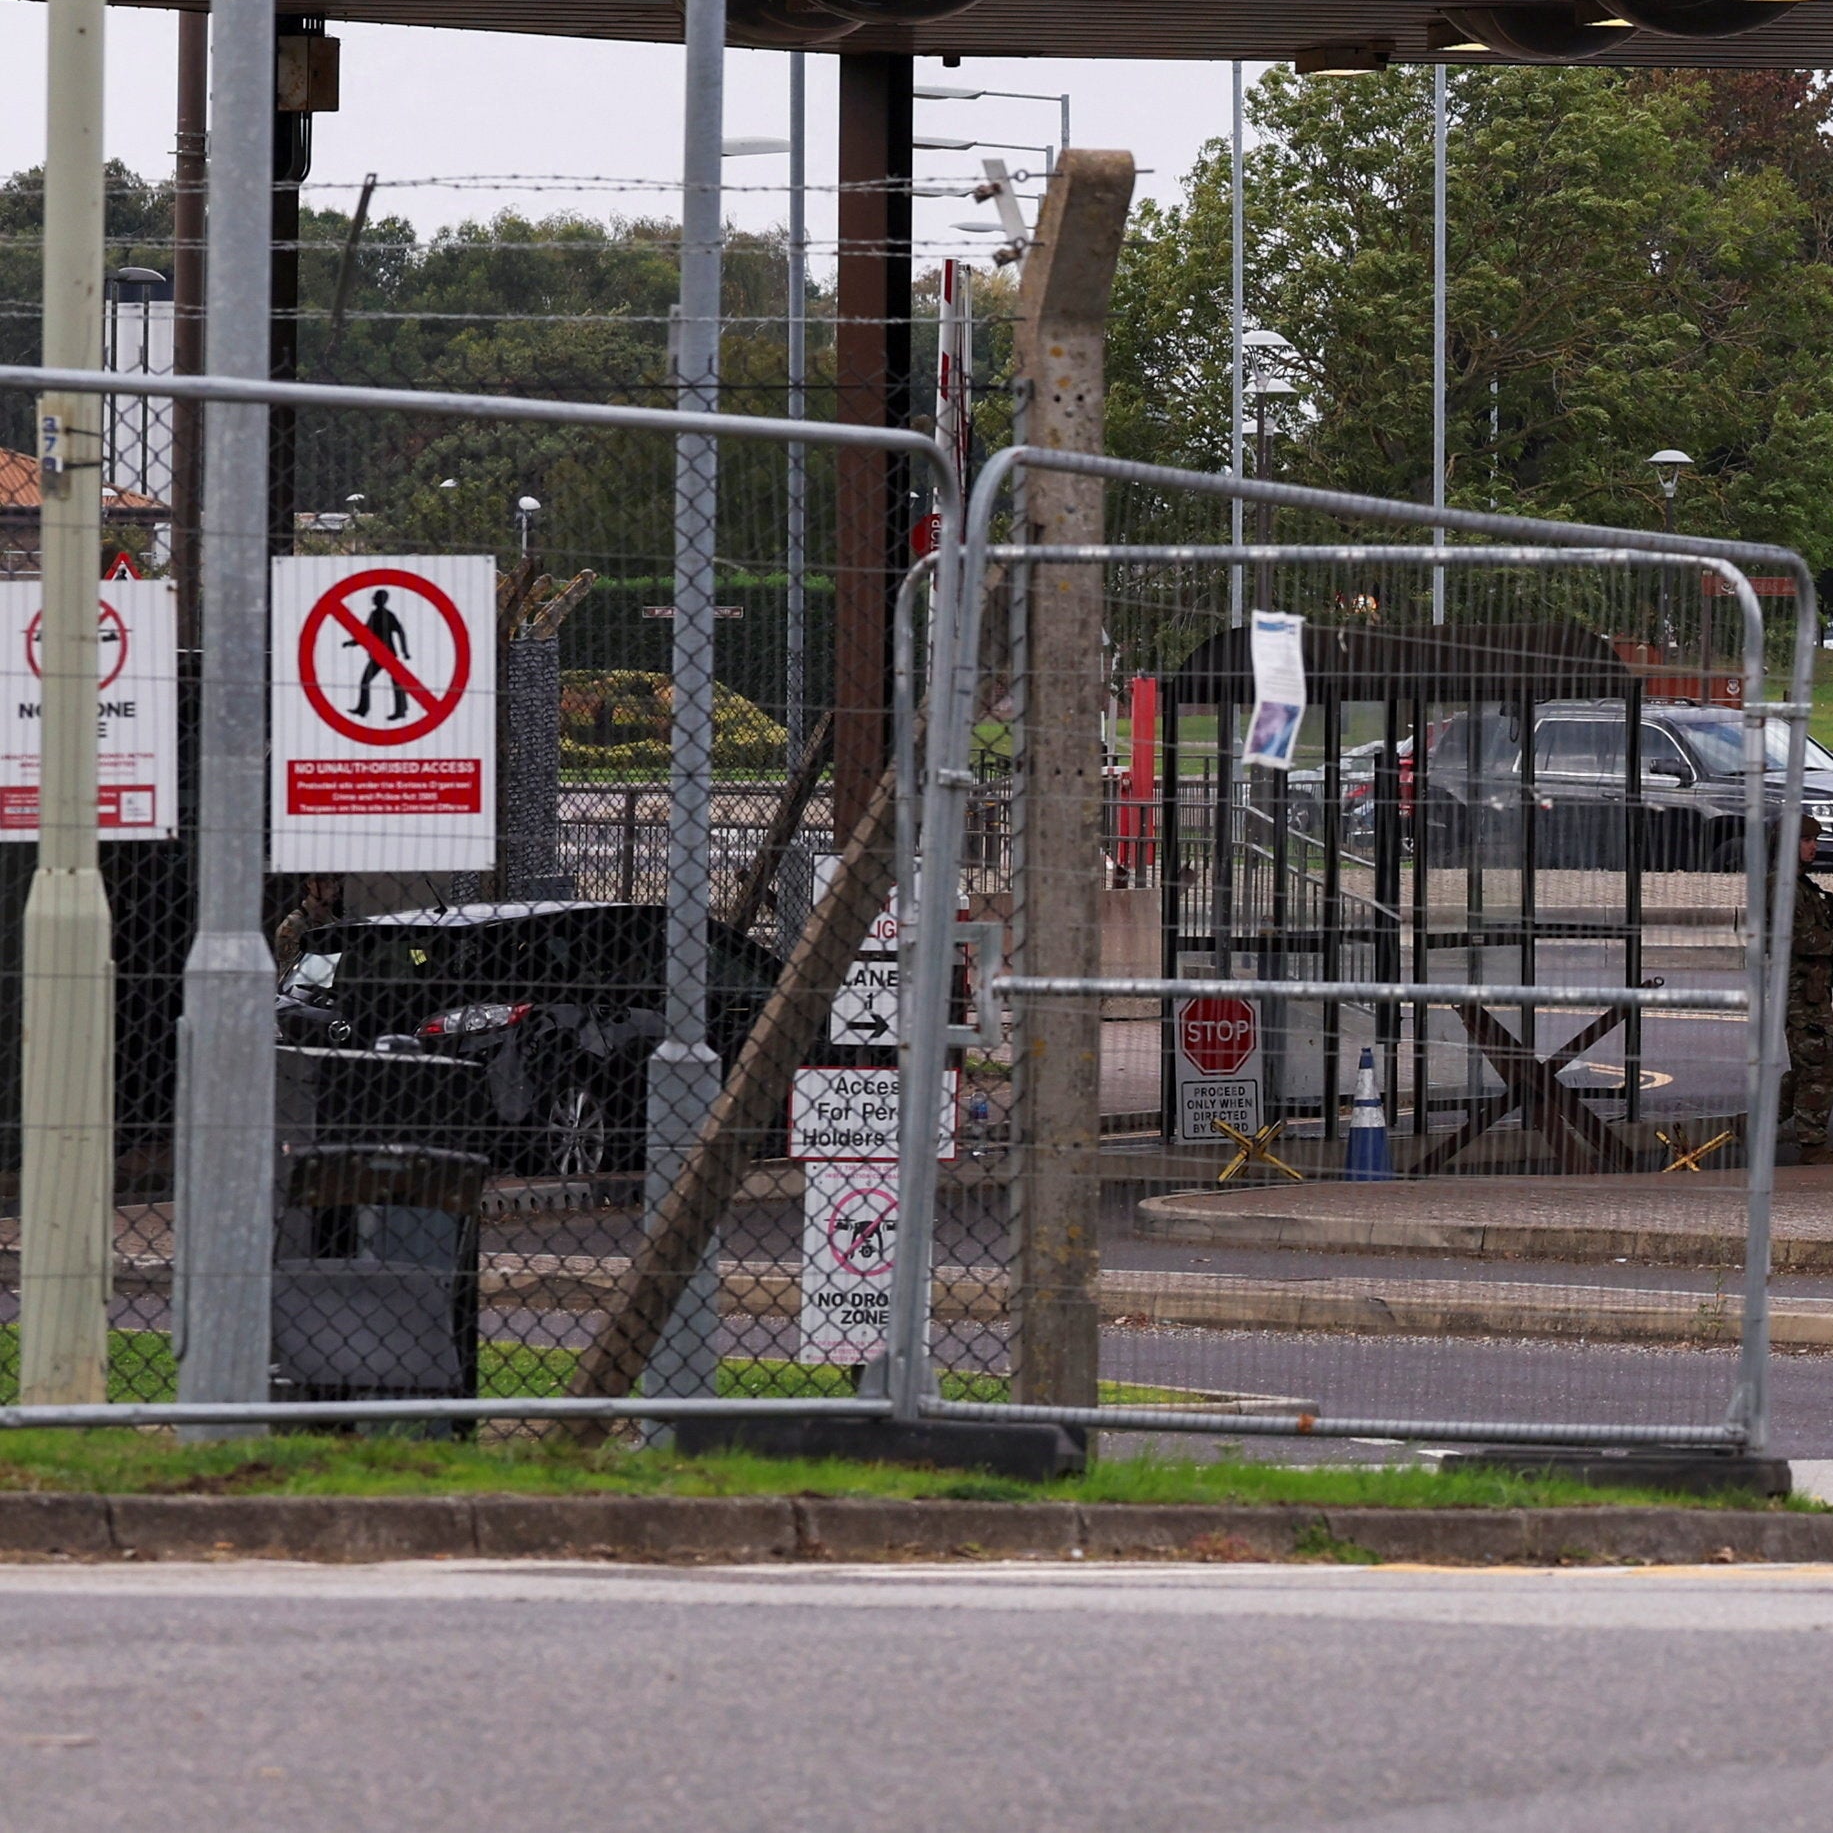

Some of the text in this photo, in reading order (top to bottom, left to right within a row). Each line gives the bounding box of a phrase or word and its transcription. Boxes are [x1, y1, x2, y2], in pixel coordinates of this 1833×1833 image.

[931, 519, 942, 554] TOP
[294, 762, 315, 774] NO
[421, 761, 475, 773] ACCESS
[1187, 1020, 1249, 1042] STOP
[835, 1076, 900, 1096] Acces
[1194, 1086, 1246, 1097] PROCEED
[817, 1102, 897, 1121] For Per
[1187, 1099, 1253, 1110] ONLY WHEN
[1193, 1111, 1248, 1121] DIRECTED
[1193, 1123, 1207, 1134] BY
[802, 1129, 885, 1147] Holders
[818, 1293, 889, 1307] NO DRO
[840, 1310, 889, 1325] ZONE
